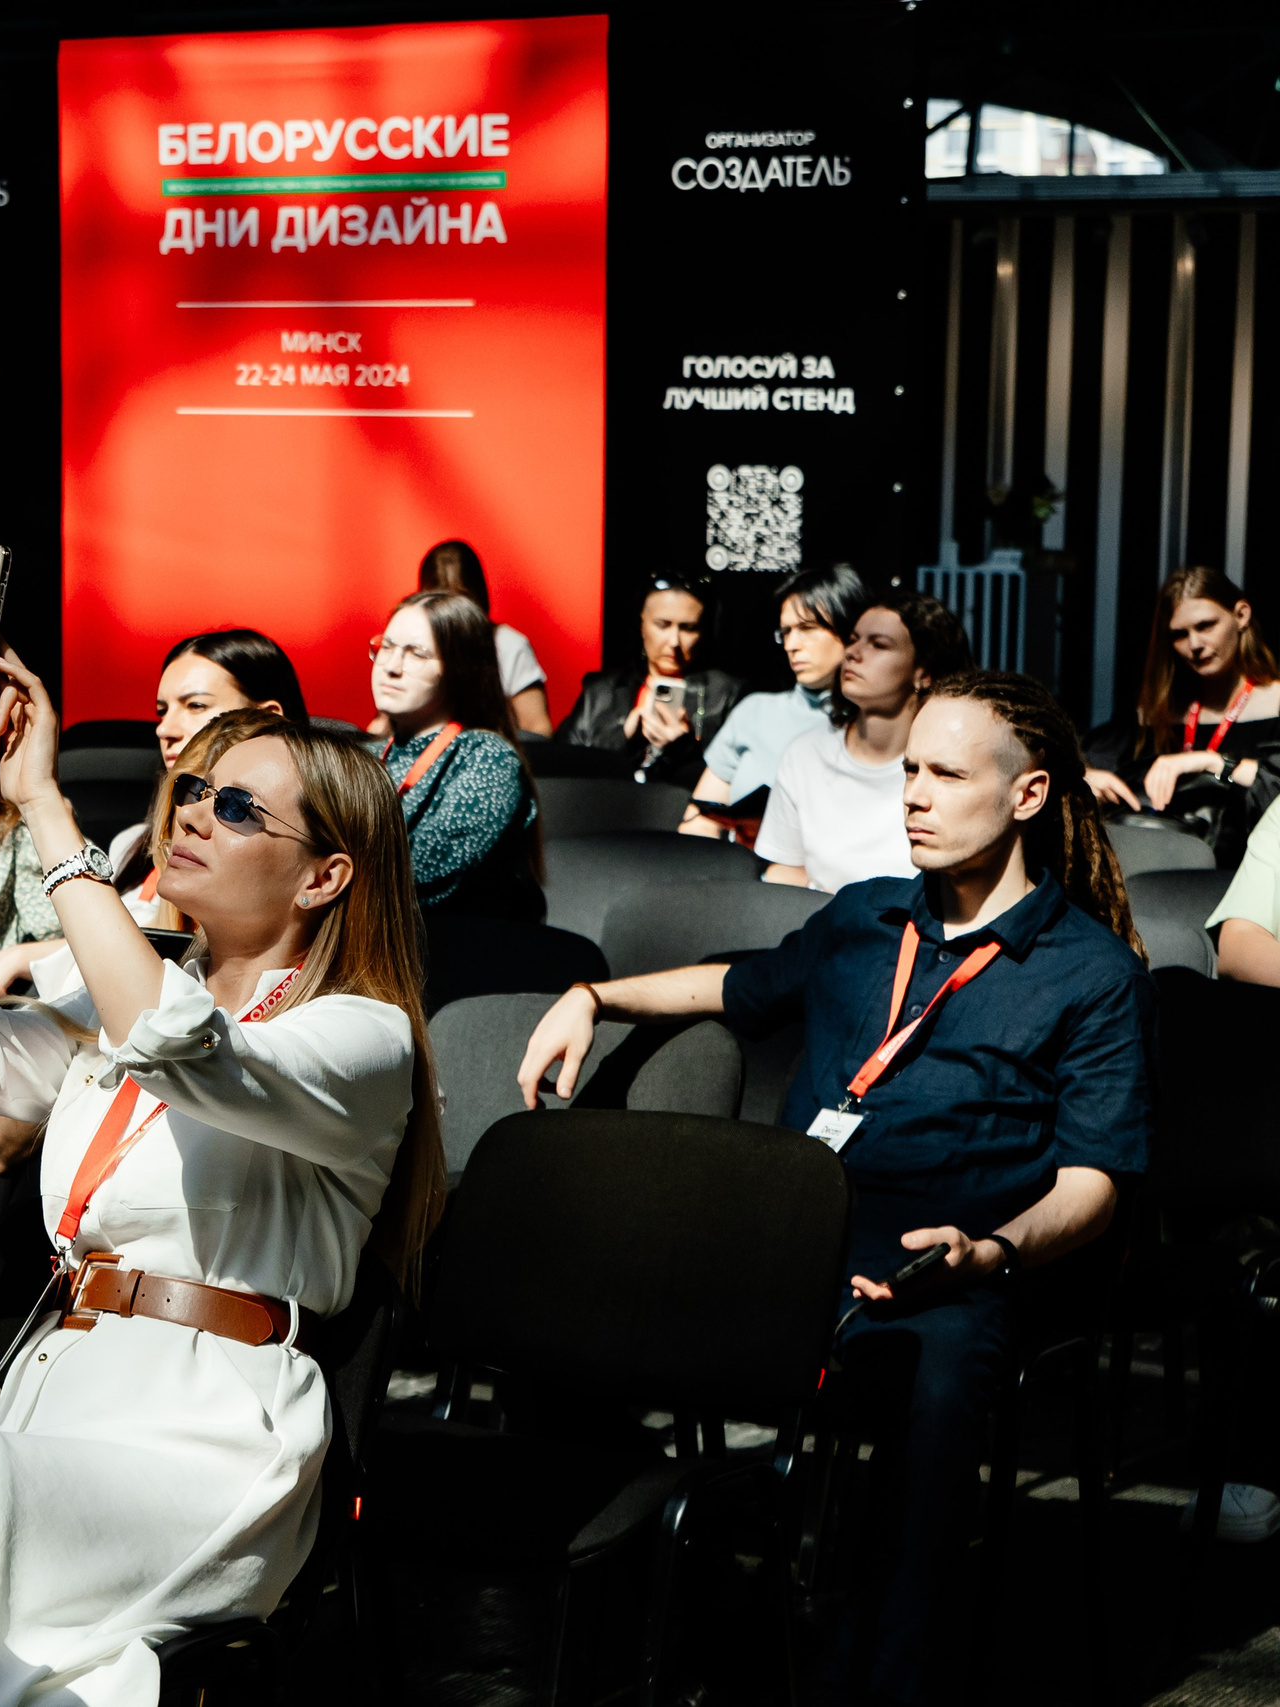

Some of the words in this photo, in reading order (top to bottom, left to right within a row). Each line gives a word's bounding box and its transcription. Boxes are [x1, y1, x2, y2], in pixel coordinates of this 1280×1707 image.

[158, 113, 510, 166] БЕЛОРУССКИЕ
[705, 130, 816, 149] ОРГАНИЗАТОР
[671, 155, 851, 193] СОЗДАТЕЛЬ
[159, 207, 260, 255] ДНИ
[271, 196, 508, 253] ДИЗАЙНА
[281, 331, 362, 353] МИНСК
[236, 363, 296, 386] 22-24
[300, 364, 350, 386] МАЯ
[354, 364, 410, 387] 2024
[682, 352, 798, 379] ГОЛОСУЙ
[801, 355, 835, 379] ЗА
[663, 384, 769, 410] ЛУЧШИЙ
[772, 387, 856, 414] СТЕНД
